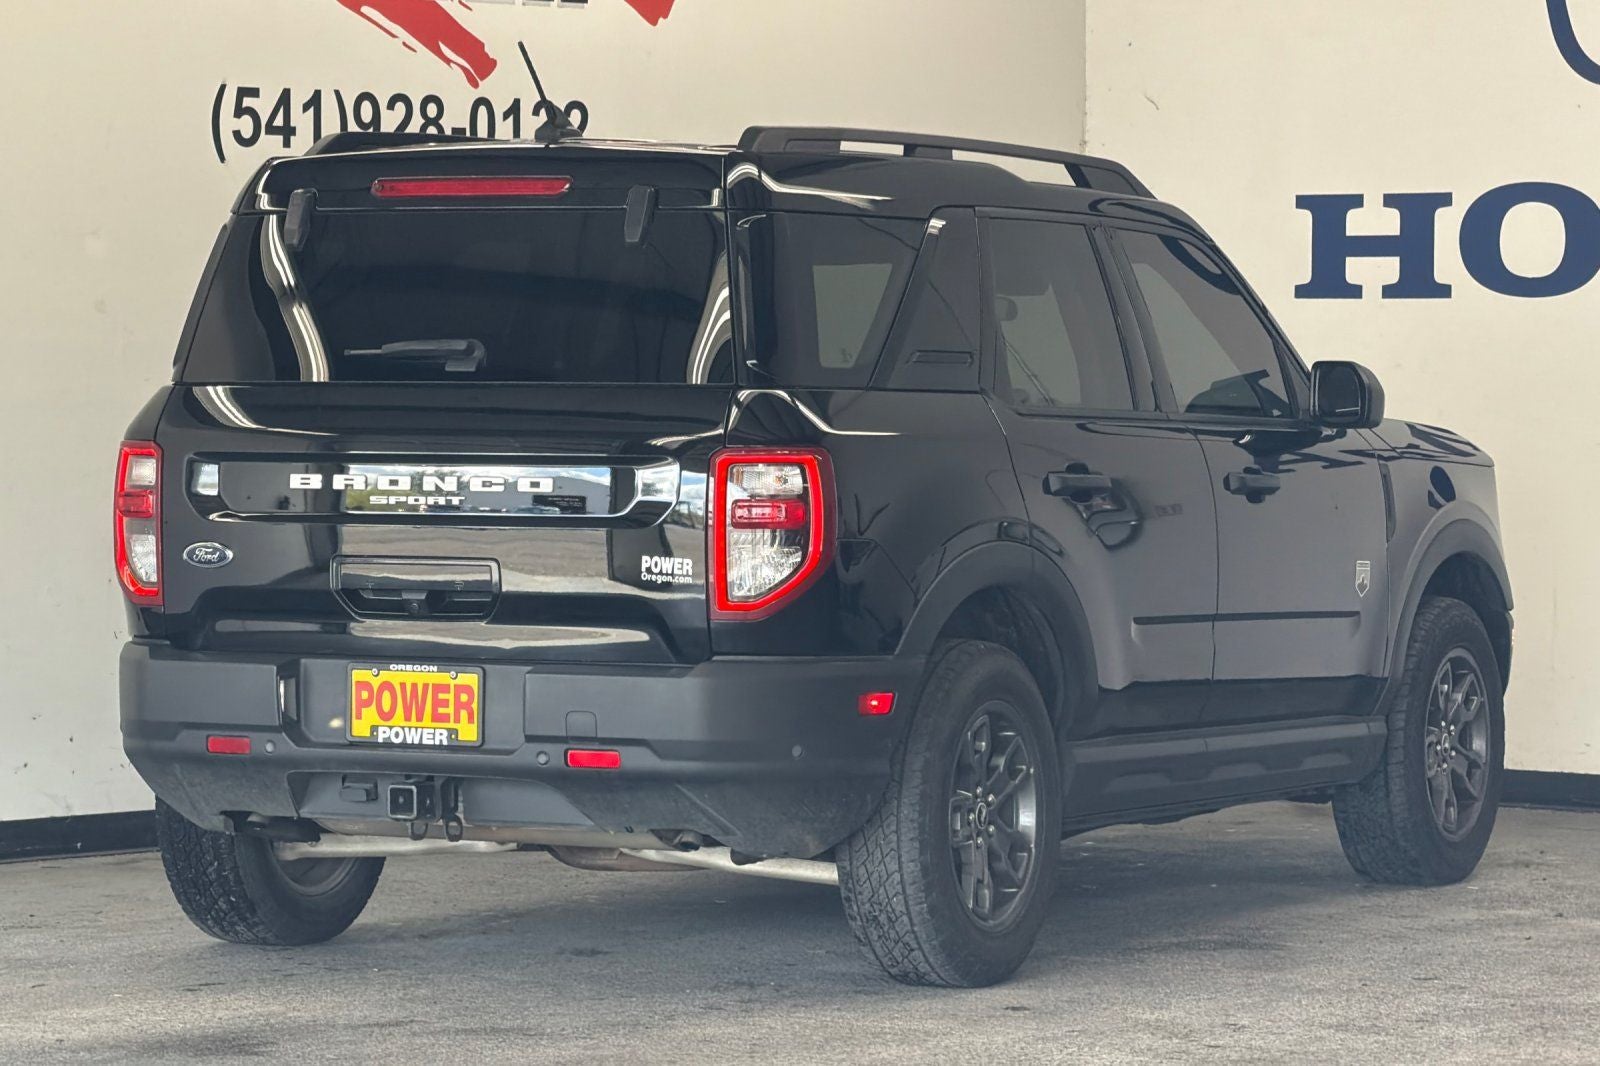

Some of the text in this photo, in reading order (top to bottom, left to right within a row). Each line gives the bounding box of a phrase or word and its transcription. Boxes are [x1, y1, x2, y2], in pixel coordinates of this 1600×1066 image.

[289, 473, 554, 493] BRONCO
[369, 495, 466, 505] SPORT
[193, 547, 220, 562] Ford
[641, 555, 693, 576] POWER
[641, 572, 693, 584] Oregon.com
[389, 664, 438, 672] OREGON
[354, 680, 475, 725] POWER
[377, 726, 448, 746] POWER
